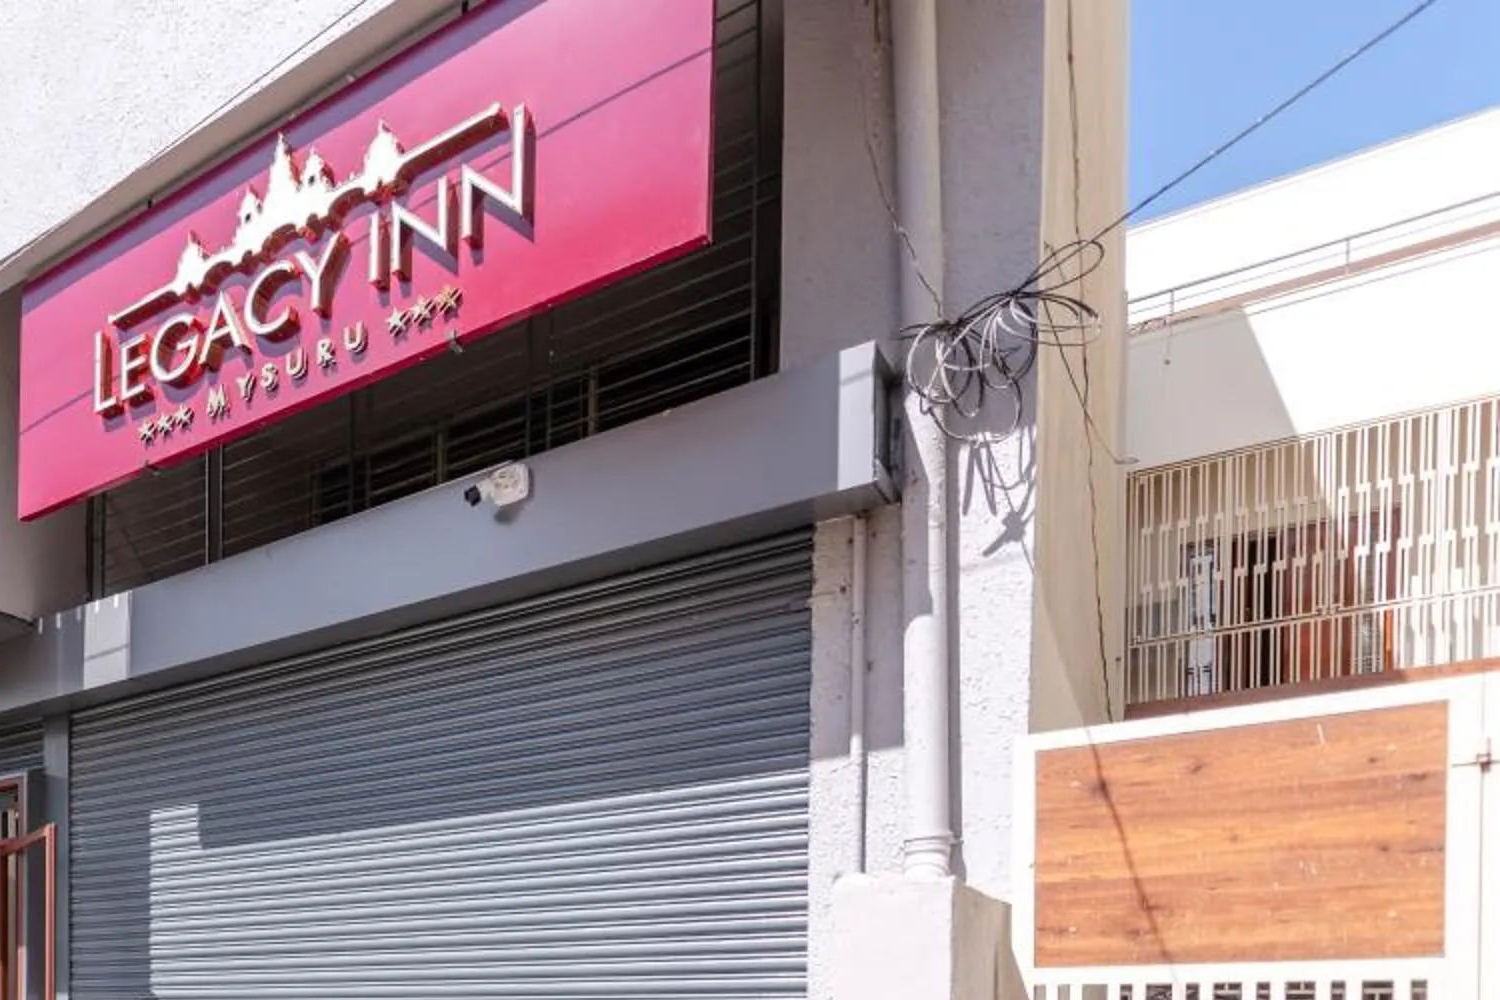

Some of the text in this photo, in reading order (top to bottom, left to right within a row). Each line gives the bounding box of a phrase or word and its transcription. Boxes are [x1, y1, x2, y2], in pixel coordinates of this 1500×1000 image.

[93, 101, 530, 414] LEGACY INN
[207, 320, 368, 419] MYSURU
